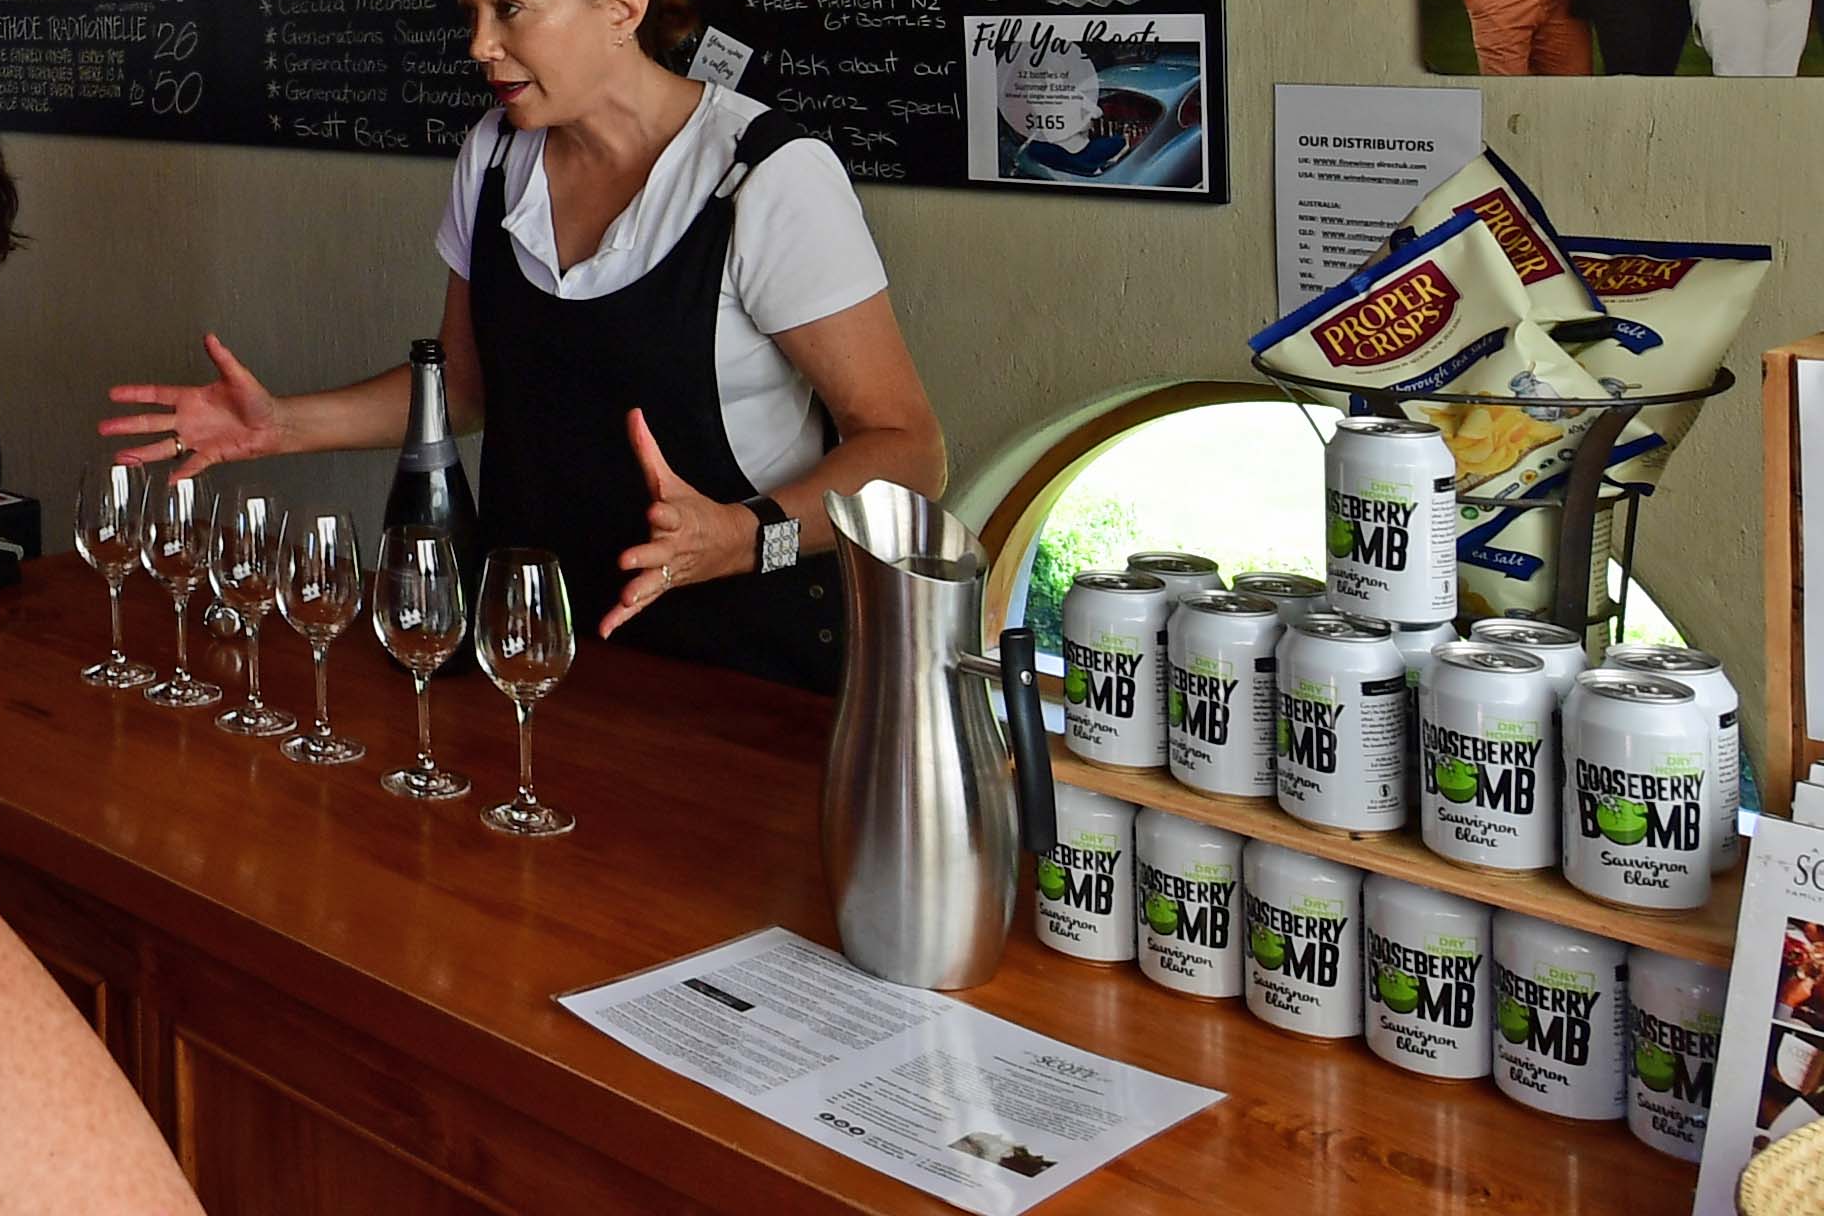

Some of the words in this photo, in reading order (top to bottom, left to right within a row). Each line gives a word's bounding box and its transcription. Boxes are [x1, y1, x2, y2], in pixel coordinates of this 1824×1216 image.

[855, 12, 947, 30] BOTTLES
[280, 20, 386, 46] Generations
[393, 19, 474, 55] Sauvigno
[283, 51, 388, 75] Generations
[779, 48, 831, 77] Ask
[838, 49, 899, 75] about
[913, 60, 960, 77] our
[284, 78, 389, 104] Generations
[294, 111, 348, 141] Scott
[353, 116, 410, 148] Base
[1024, 112, 1066, 131] $165
[1297, 134, 1330, 149] OUR
[1332, 136, 1436, 153] DISTRIBUTORS
[1322, 273, 1449, 358] PROPER
[1354, 303, 1442, 361] CRISPS
[1471, 548, 1490, 562] ea
[1492, 551, 1527, 568] salt
[1422, 717, 1544, 769] GOOSEBERRY
[1575, 757, 1706, 802] GOOSEBERRY
[1437, 806, 1520, 838] Sauvignon
[1454, 826, 1499, 848] Blanc
[1600, 849, 1689, 878] Sauvignon
[1623, 870, 1671, 890] Blanc
[1379, 1014, 1460, 1050] Sauvignon
[1395, 1035, 1438, 1060] Blanc
